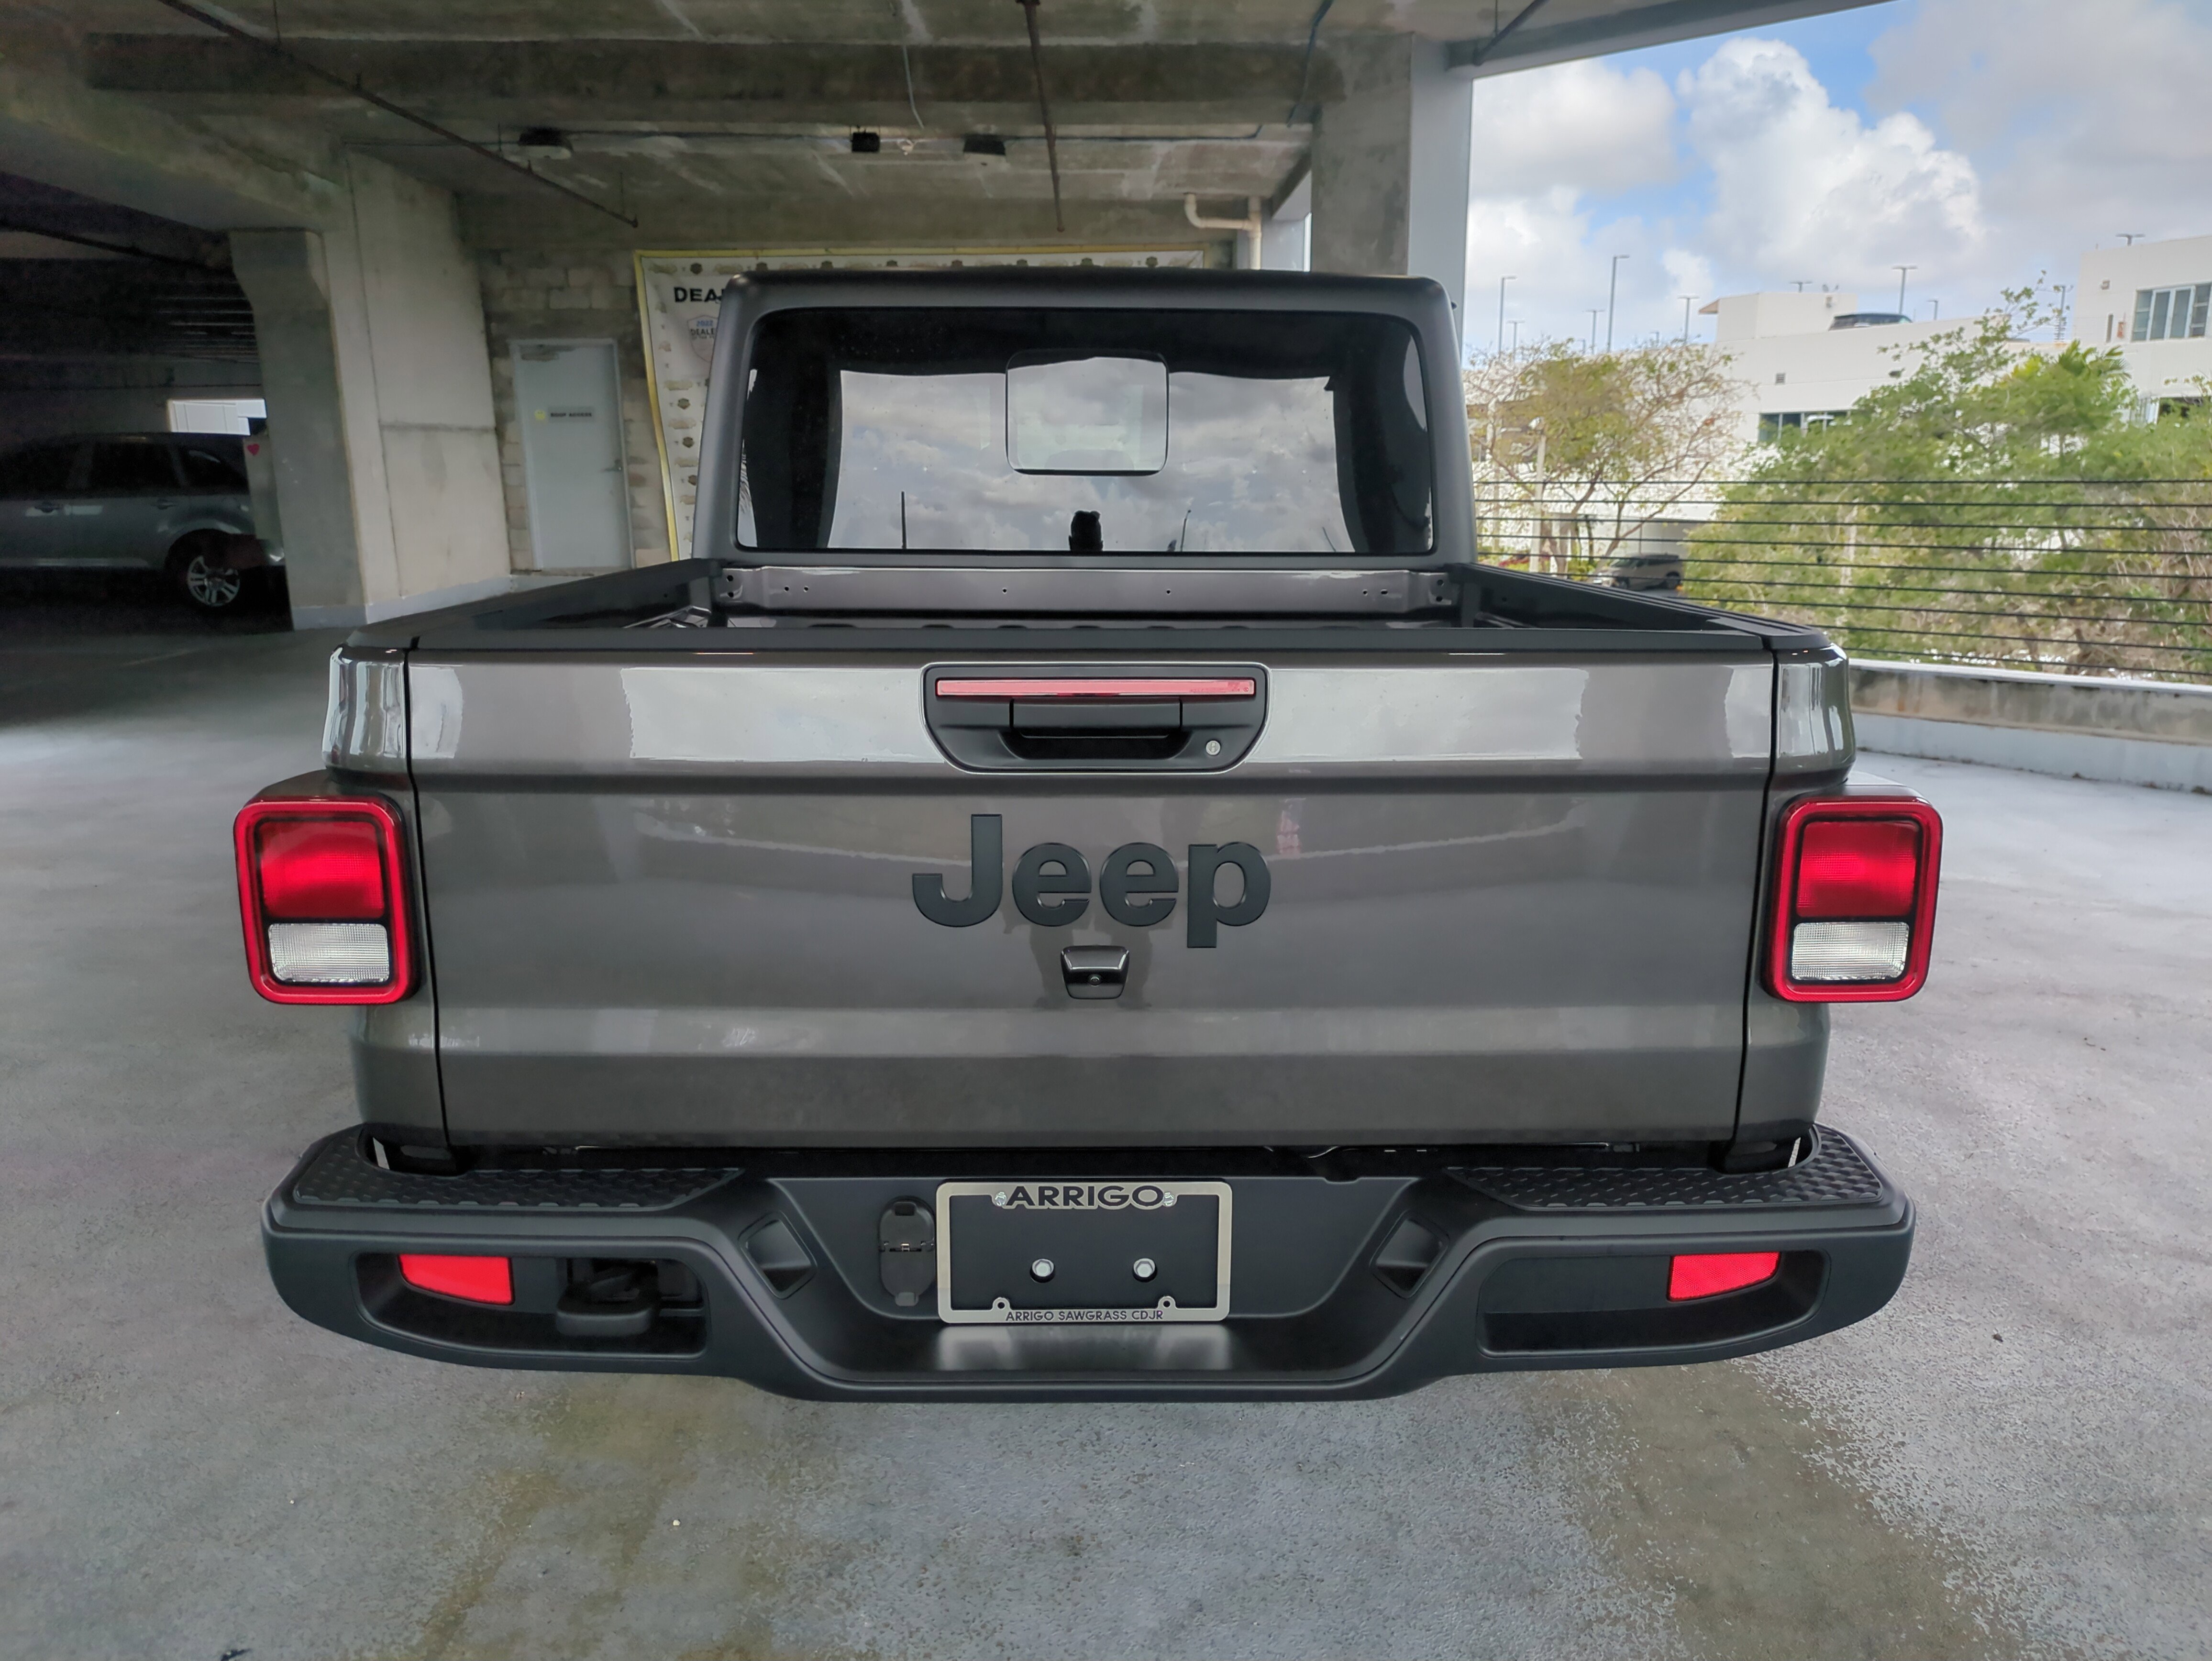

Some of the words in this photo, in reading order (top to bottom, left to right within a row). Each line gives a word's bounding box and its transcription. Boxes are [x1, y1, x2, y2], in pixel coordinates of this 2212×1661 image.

[674, 287, 726, 302] DEA
[912, 813, 1271, 948] Jeep
[1006, 1185, 1164, 1207] ARRIGO
[1006, 1311, 1054, 1321] ARRIGO
[1058, 1310, 1127, 1320] SAWGRASS
[1131, 1309, 1163, 1320] CDJR
